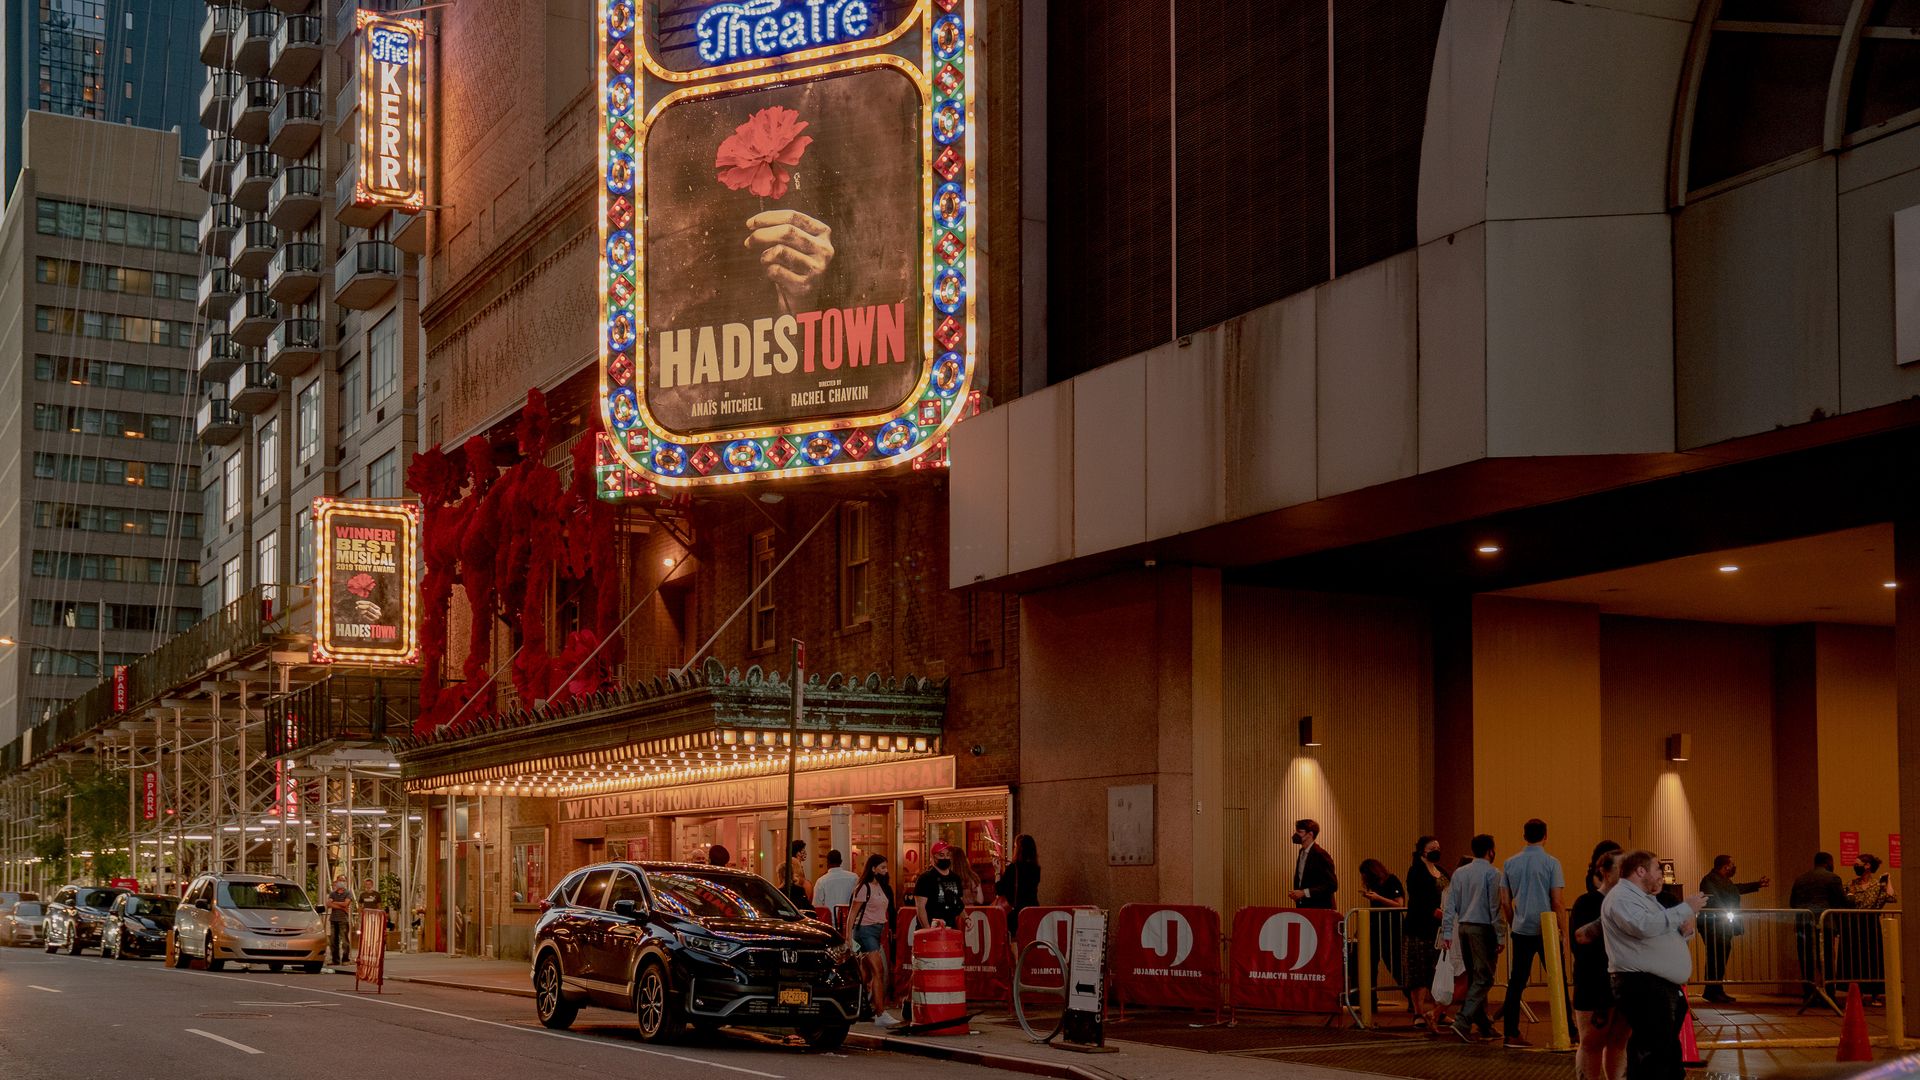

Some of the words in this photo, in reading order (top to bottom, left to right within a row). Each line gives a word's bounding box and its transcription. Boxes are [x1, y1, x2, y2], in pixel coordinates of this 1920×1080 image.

[696, 0, 868, 62] Theatre
[372, 30, 408, 64] The
[380, 61, 402, 189] KERR
[659, 303, 905, 388] HADESTOWN
[691, 399, 718, 417] ANAÏS
[721, 396, 763, 414] MITCHELL
[791, 389, 826, 407] RACHEL
[828, 385, 869, 404] CHAVKIN
[336, 526, 396, 541] WINNER!
[336, 539, 395, 553] BEST
[336, 551, 396, 566] MUSICAL
[336, 563, 353, 571] 2019
[354, 564, 372, 572] TONY
[372, 565, 395, 573] AWARD
[335, 624, 396, 639] HADESTOWN
[117, 676, 125, 703] PARK
[147, 782, 155, 811] PARK
[566, 797, 651, 819] WINNER!
[666, 788, 697, 811] TONY
[699, 782, 755, 808] AWARDS
[848, 761, 949, 794] MUSICAL
[1132, 968, 1169, 976] JUJAMCYN
[1170, 969, 1202, 978] THEATERS
[1248, 971, 1287, 980] JUJAMCYN
[1289, 973, 1327, 982] THEATERS
